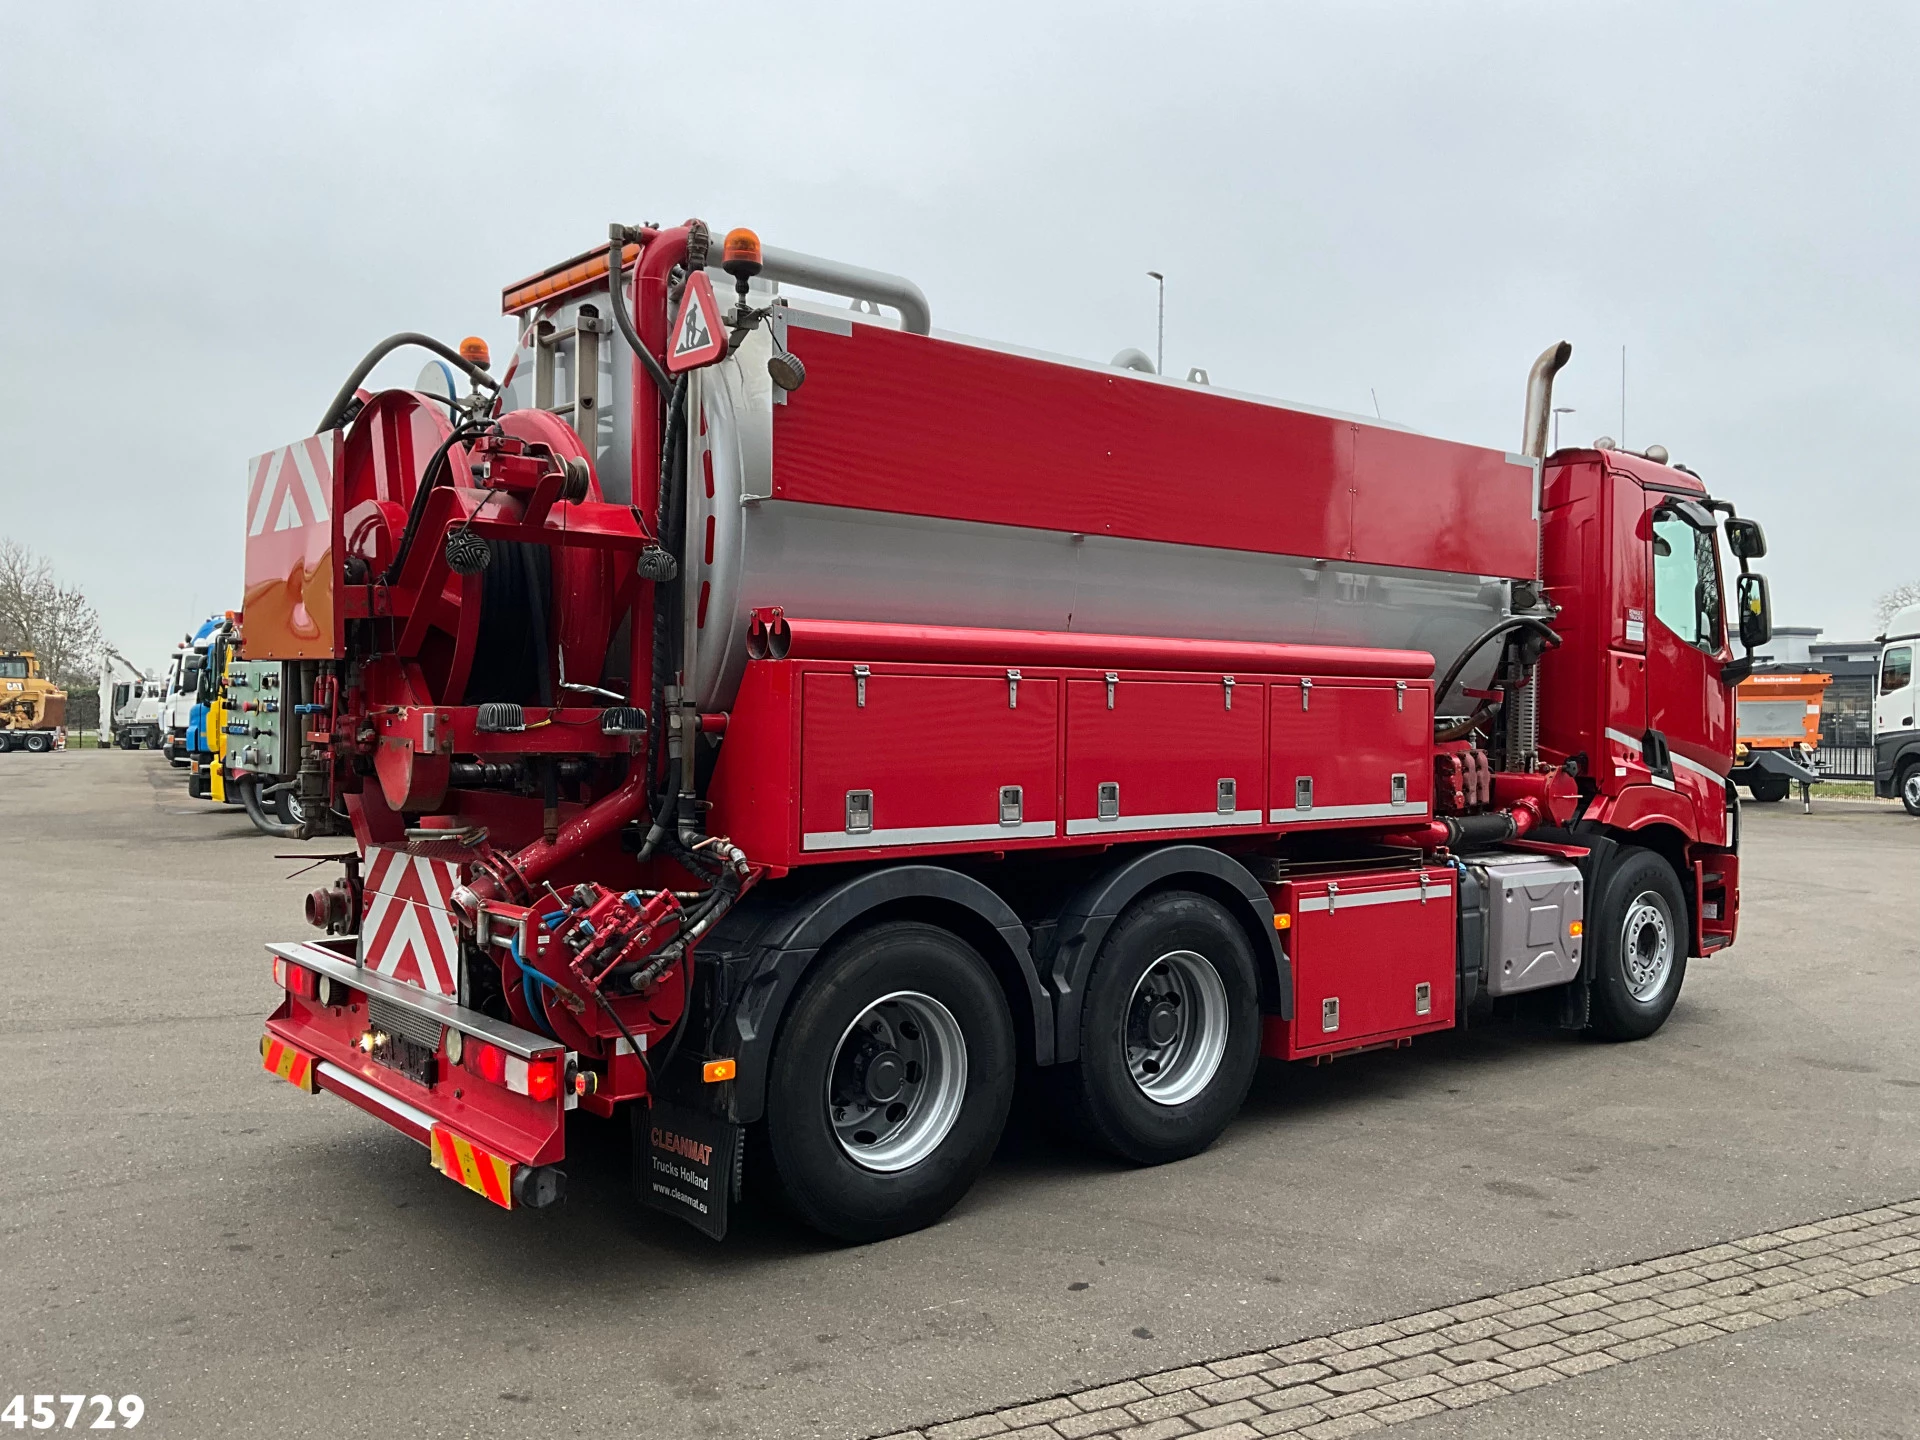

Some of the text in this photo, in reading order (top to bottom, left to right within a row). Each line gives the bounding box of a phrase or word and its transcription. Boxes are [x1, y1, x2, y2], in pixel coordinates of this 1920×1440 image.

[6, 682, 23, 691] CAT
[650, 1127, 713, 1166] CLEANMAT
[652, 1156, 709, 1191] Trucks Holland
[652, 1182, 708, 1214] www.cleanmat.eu
